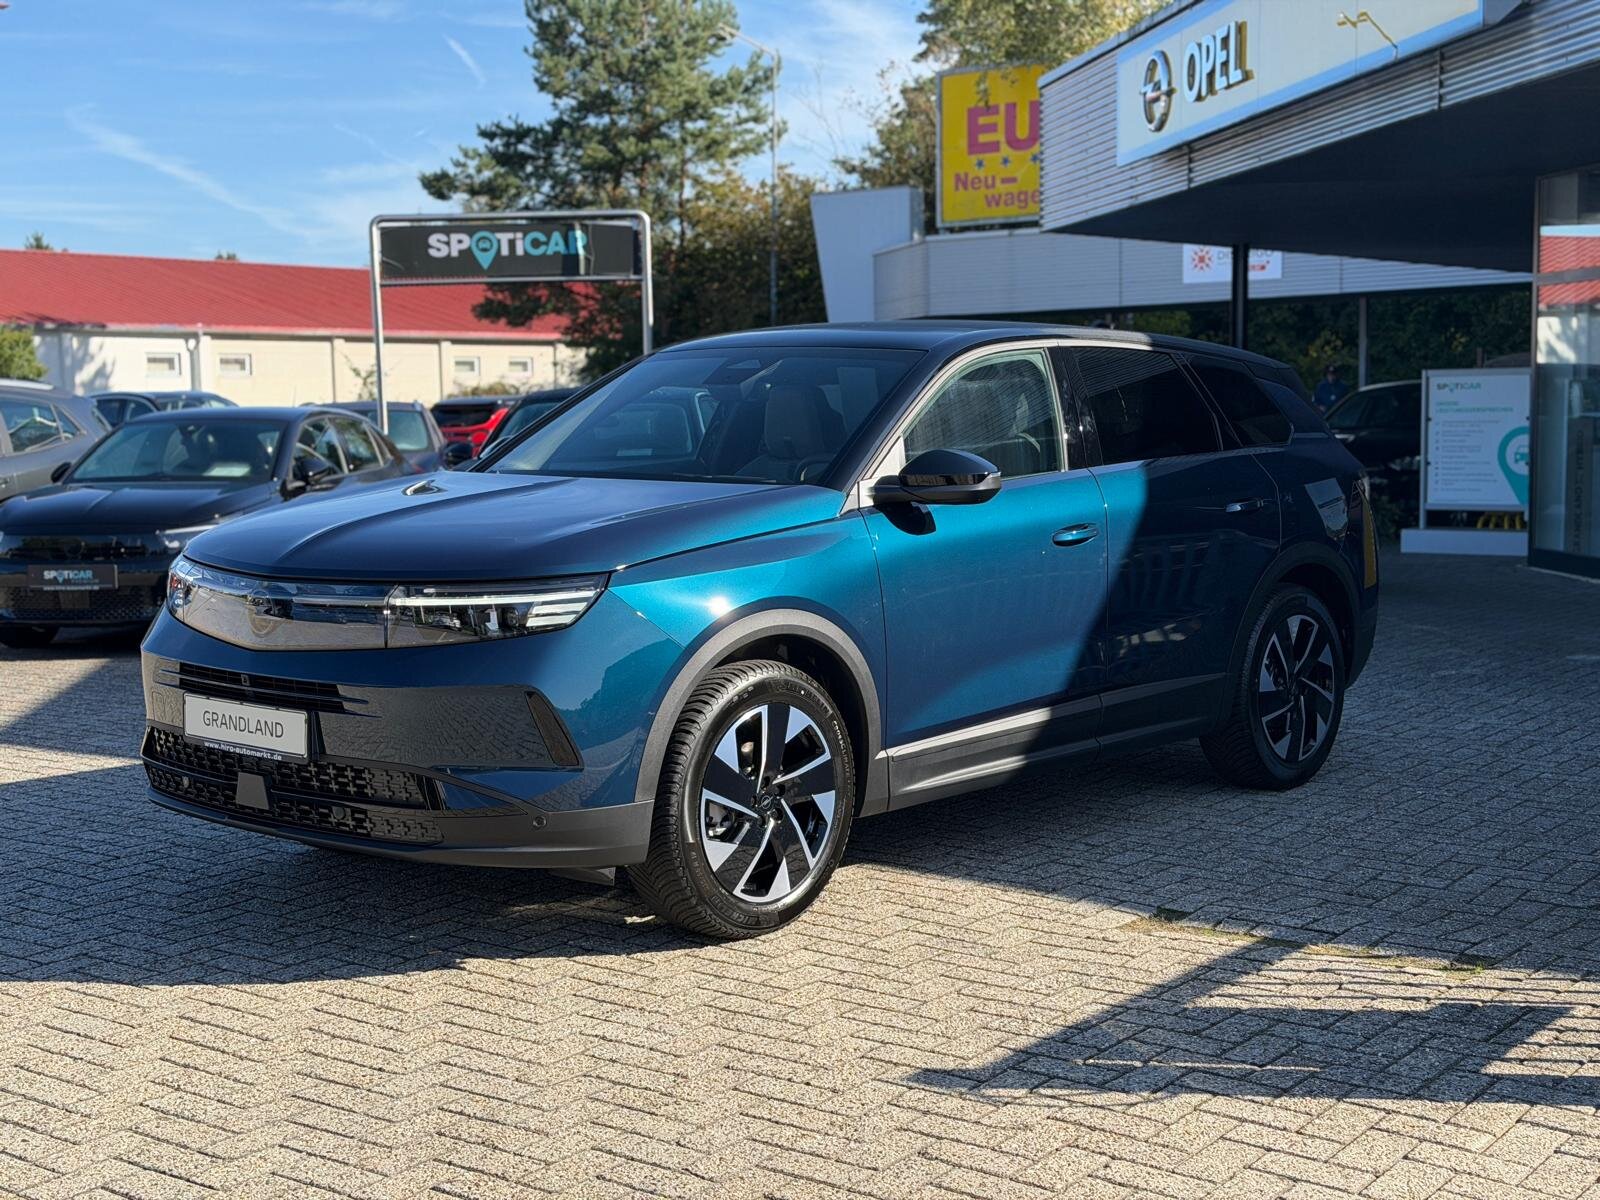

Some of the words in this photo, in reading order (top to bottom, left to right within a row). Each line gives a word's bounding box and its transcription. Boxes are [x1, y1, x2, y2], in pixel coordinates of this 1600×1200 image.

[1182, 21, 1246, 102] OPEL
[984, 188, 1040, 212] wage
[202, 710, 284, 738] GRANDLAND
[204, 741, 282, 760] www.hiro-automarkt.de
